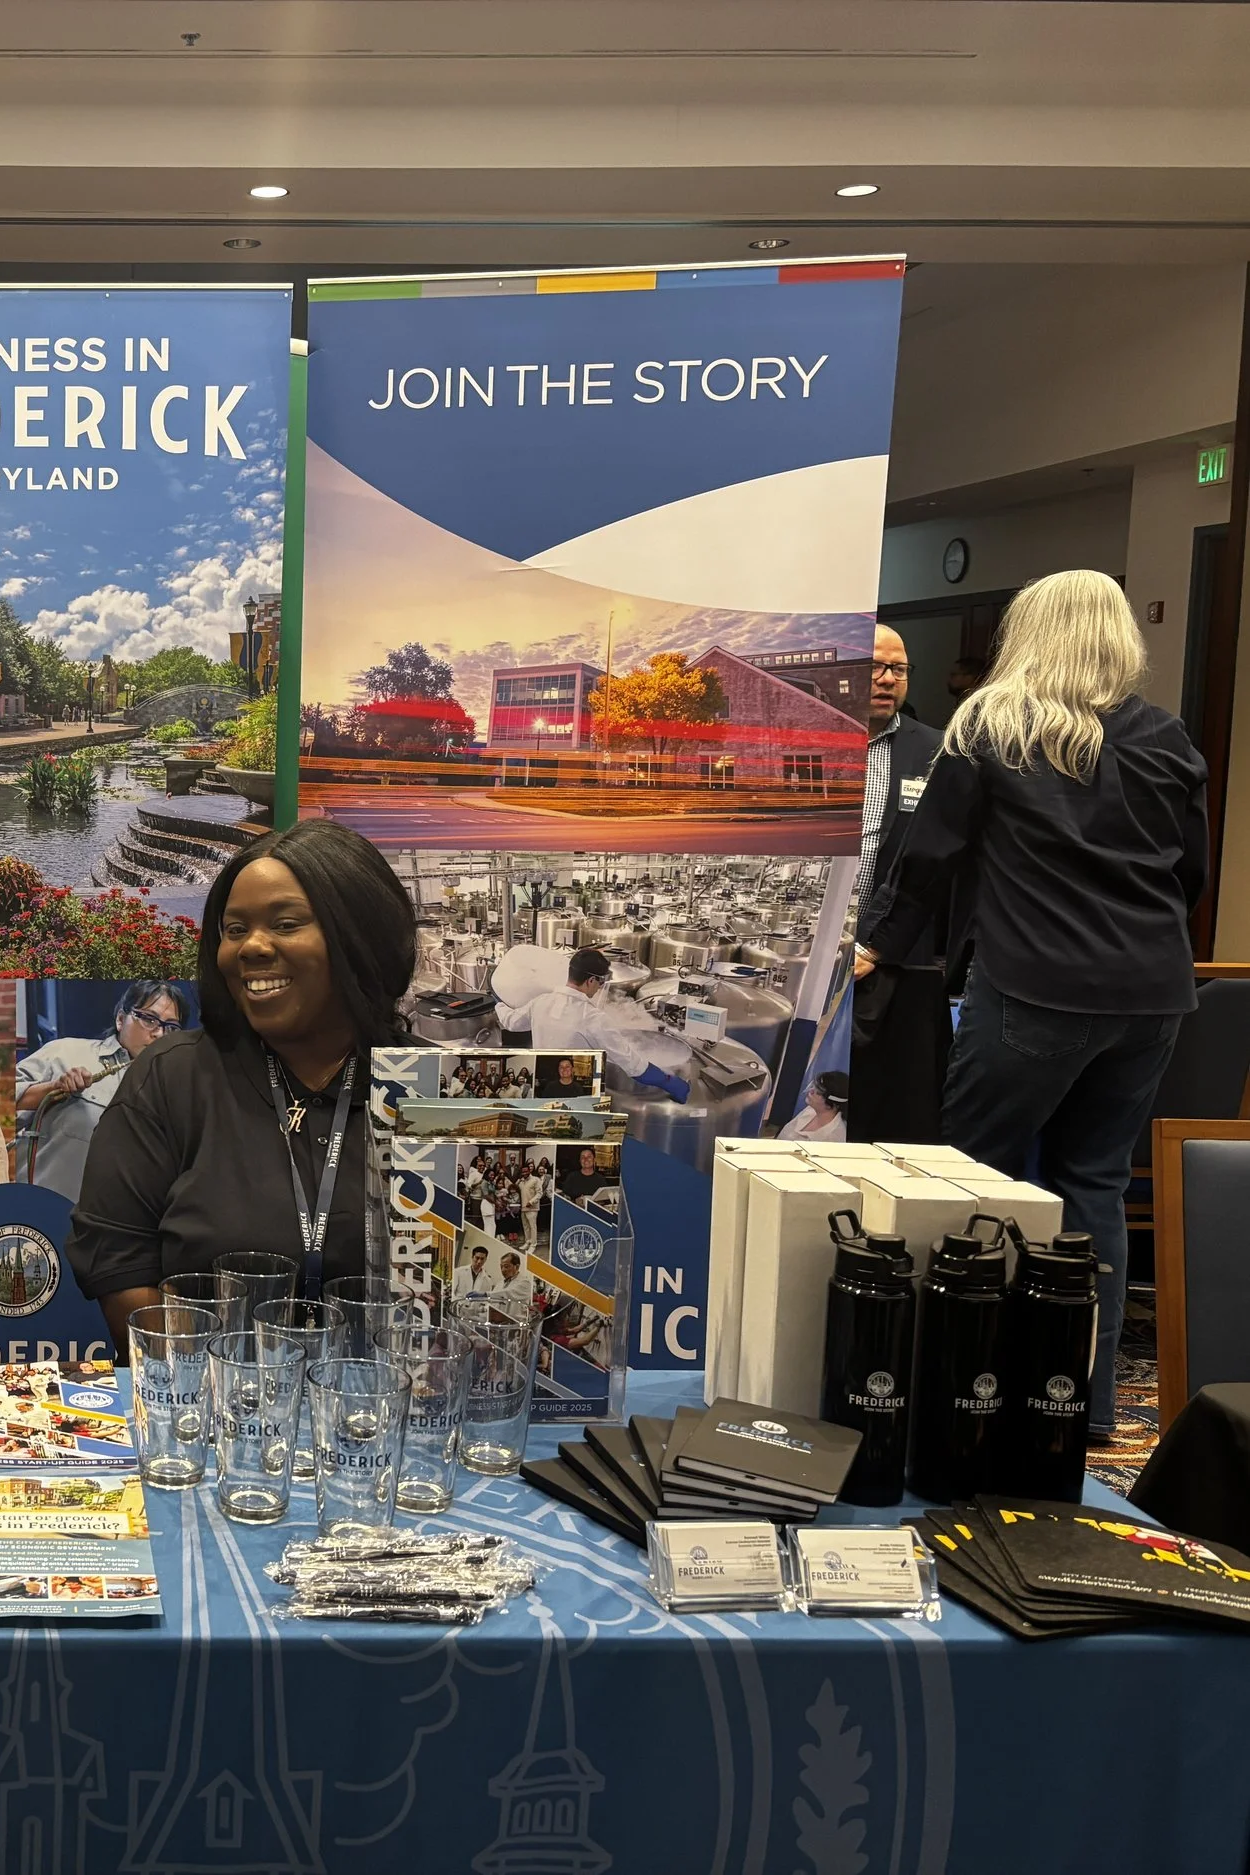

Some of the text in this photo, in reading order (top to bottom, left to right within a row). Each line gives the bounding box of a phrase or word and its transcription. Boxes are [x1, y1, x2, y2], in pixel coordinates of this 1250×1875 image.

[124, 337, 170, 372] IN
[368, 354, 829, 410] JOIN THE STORY
[1198, 448, 1226, 483] EXIT
[328, 1132, 342, 1168] FREDERICK
[12, 1227, 54, 1255] FREDERICK
[313, 1212, 326, 1252] FREDERICK
[644, 1266, 683, 1294] IN
[29, 1299, 44, 1311] 1745
[135, 1384, 199, 1405] REDERICK
[849, 1394, 905, 1407] FREDERICK
[1028, 1397, 1085, 1412] FREDERICK
[538, 1403, 568, 1412] GUIDE
[570, 1403, 592, 1412] 2025
[216, 1414, 281, 1436] REDERICK
[718, 1422, 814, 1450] FREDERICK
[28, 1522, 120, 1530] Frederick?
[678, 1566, 725, 1577] FREDERICK
[812, 1572, 860, 1581] FREDERICK
